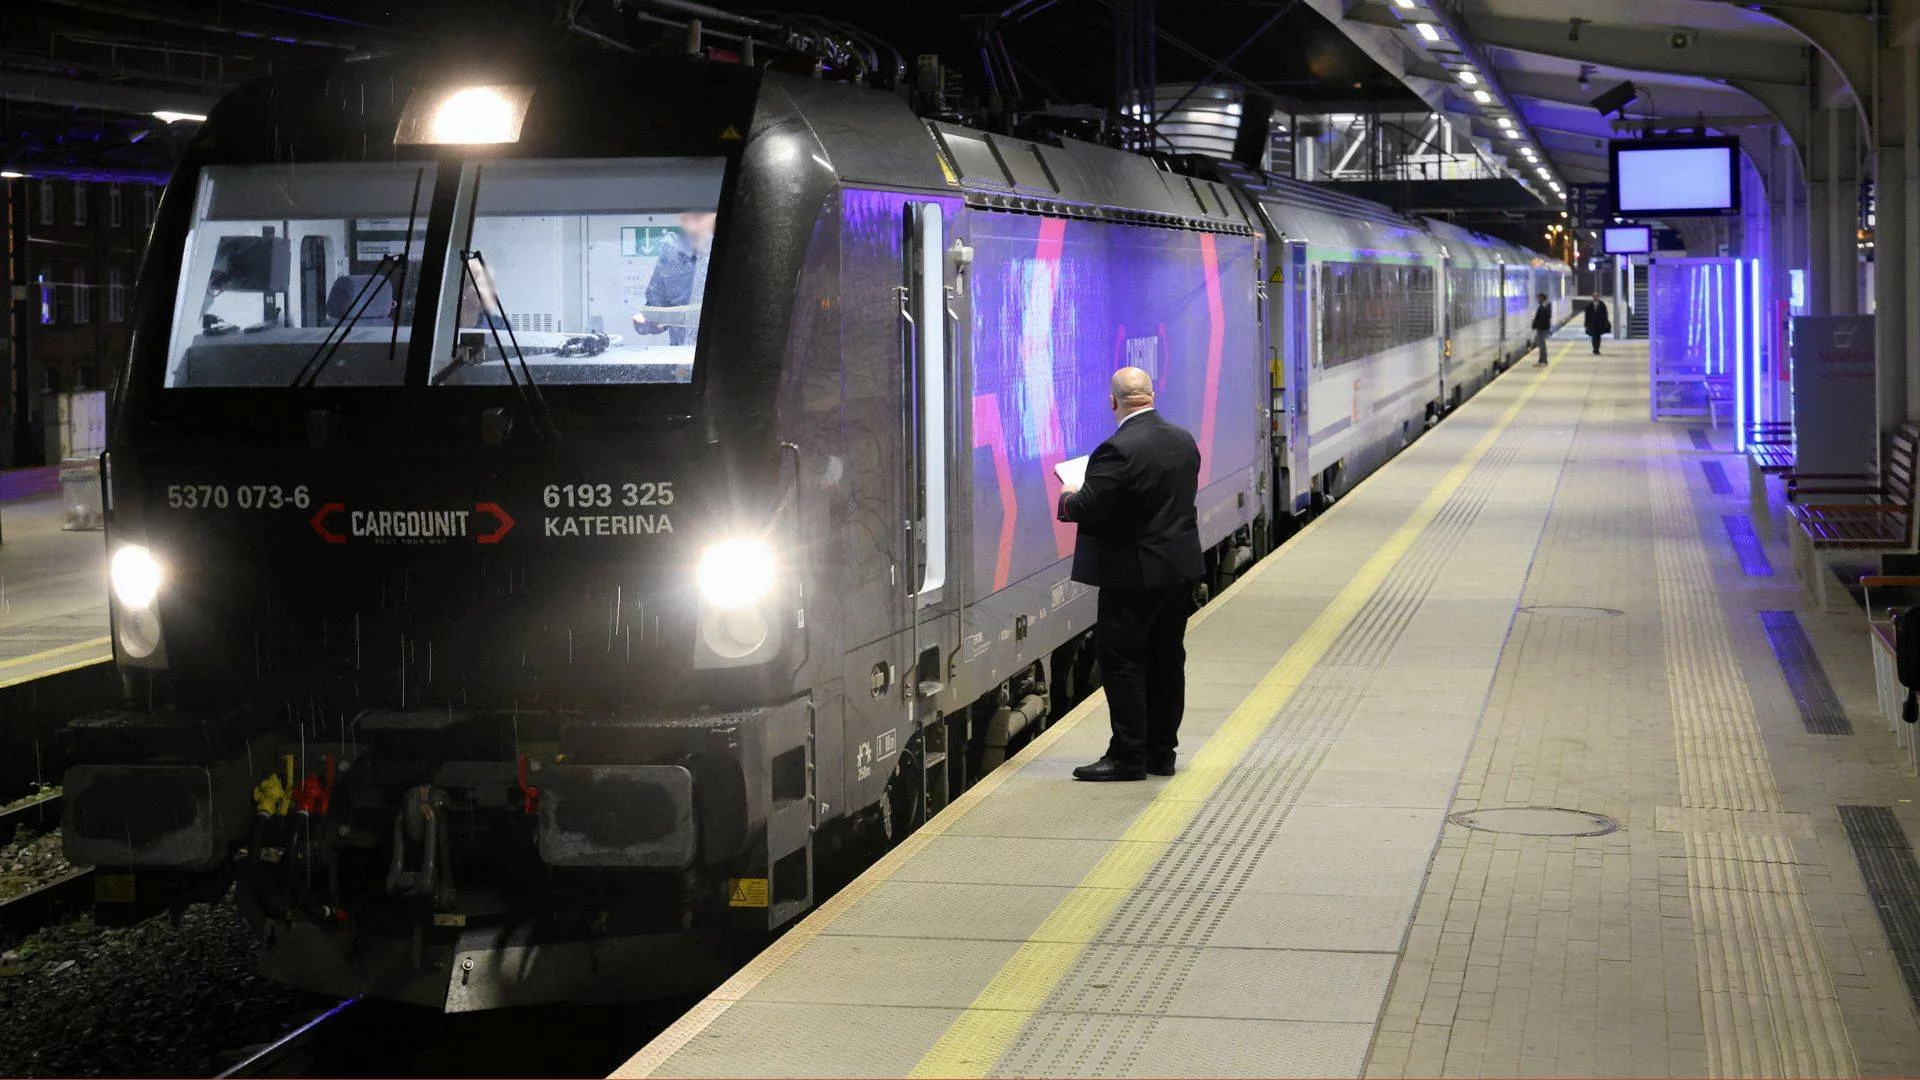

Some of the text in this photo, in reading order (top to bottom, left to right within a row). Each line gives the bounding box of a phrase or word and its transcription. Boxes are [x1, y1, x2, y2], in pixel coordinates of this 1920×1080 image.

[168, 485, 311, 509] 5370 073-6
[543, 482, 675, 508] 6193 325
[352, 511, 469, 537] CARGOUNIT
[544, 514, 674, 537] KATERINA
